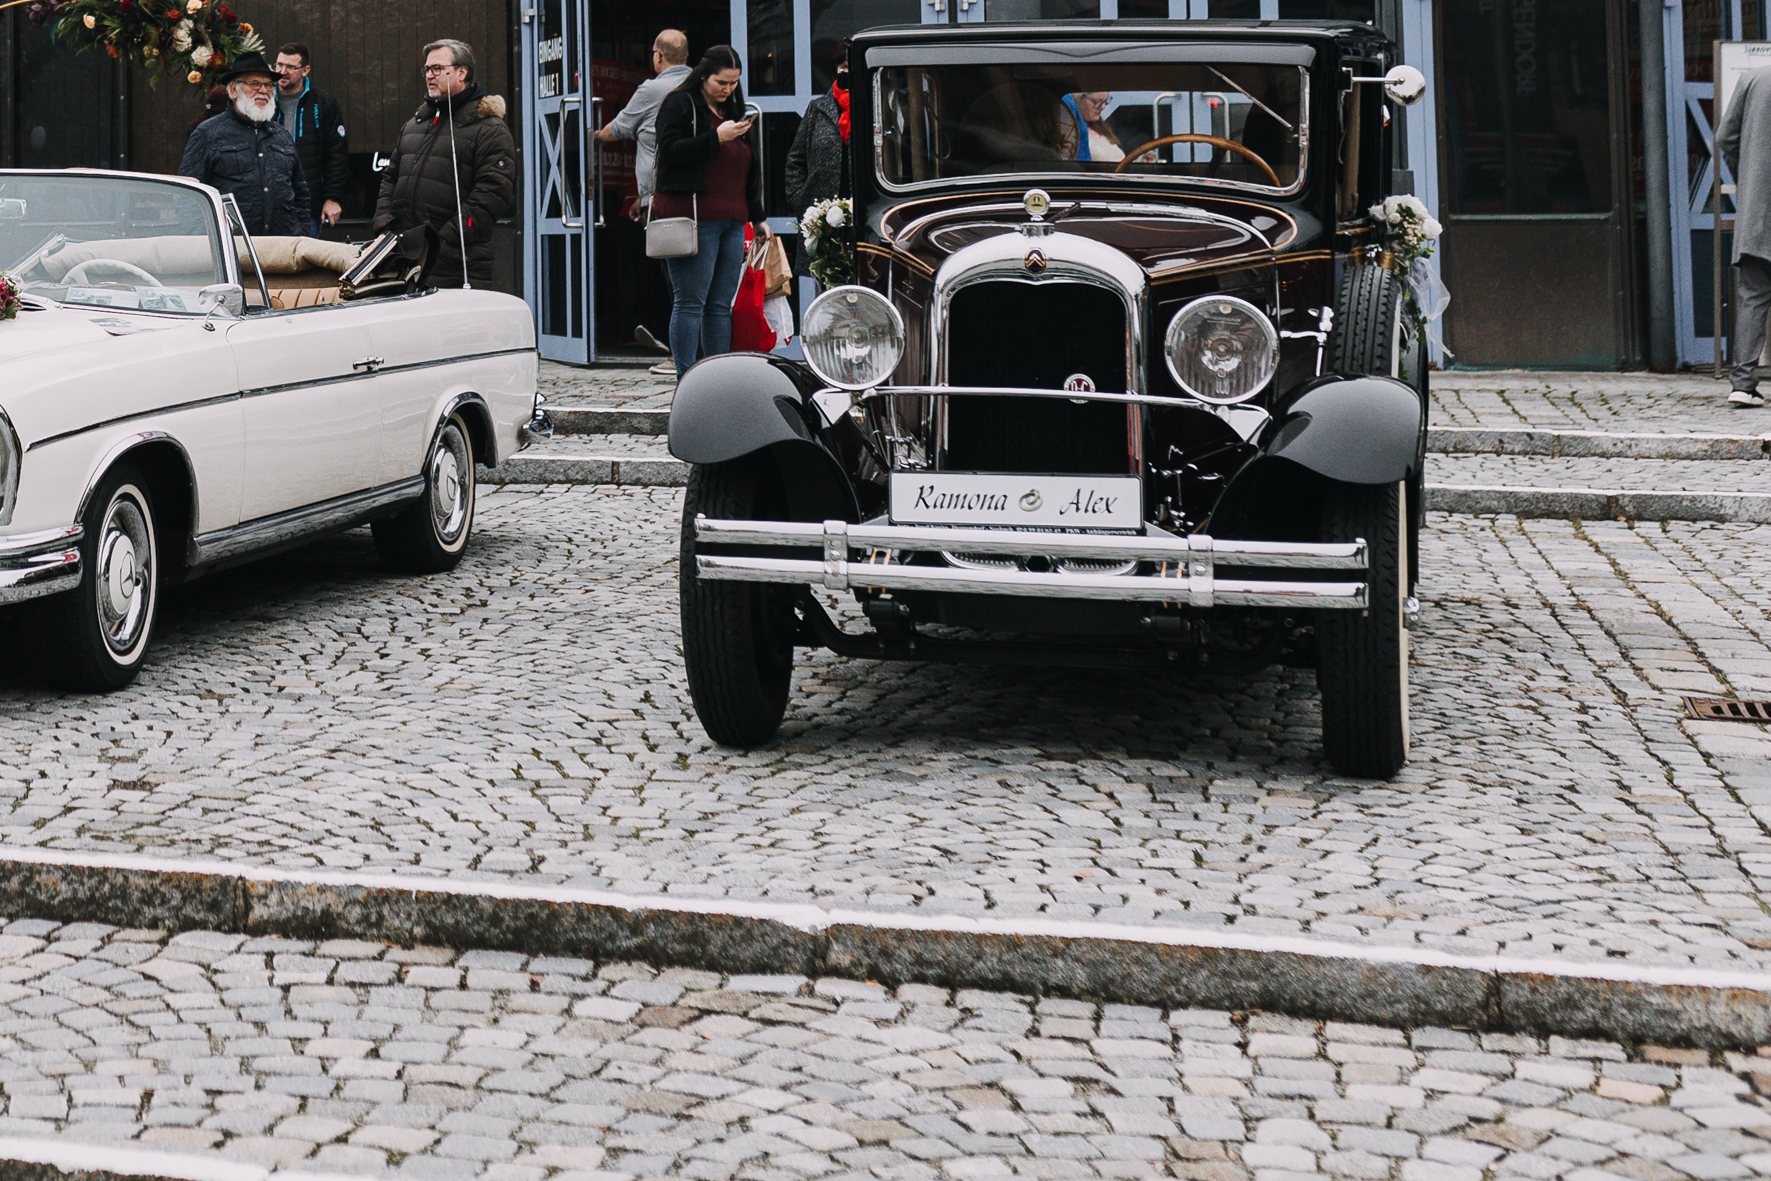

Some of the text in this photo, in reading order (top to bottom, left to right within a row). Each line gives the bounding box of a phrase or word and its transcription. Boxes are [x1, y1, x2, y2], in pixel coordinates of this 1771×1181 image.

[539, 36, 563, 64] EINGANG
[539, 72, 559, 98] HALLE 1
[913, 484, 1118, 516] Ramona Alex
